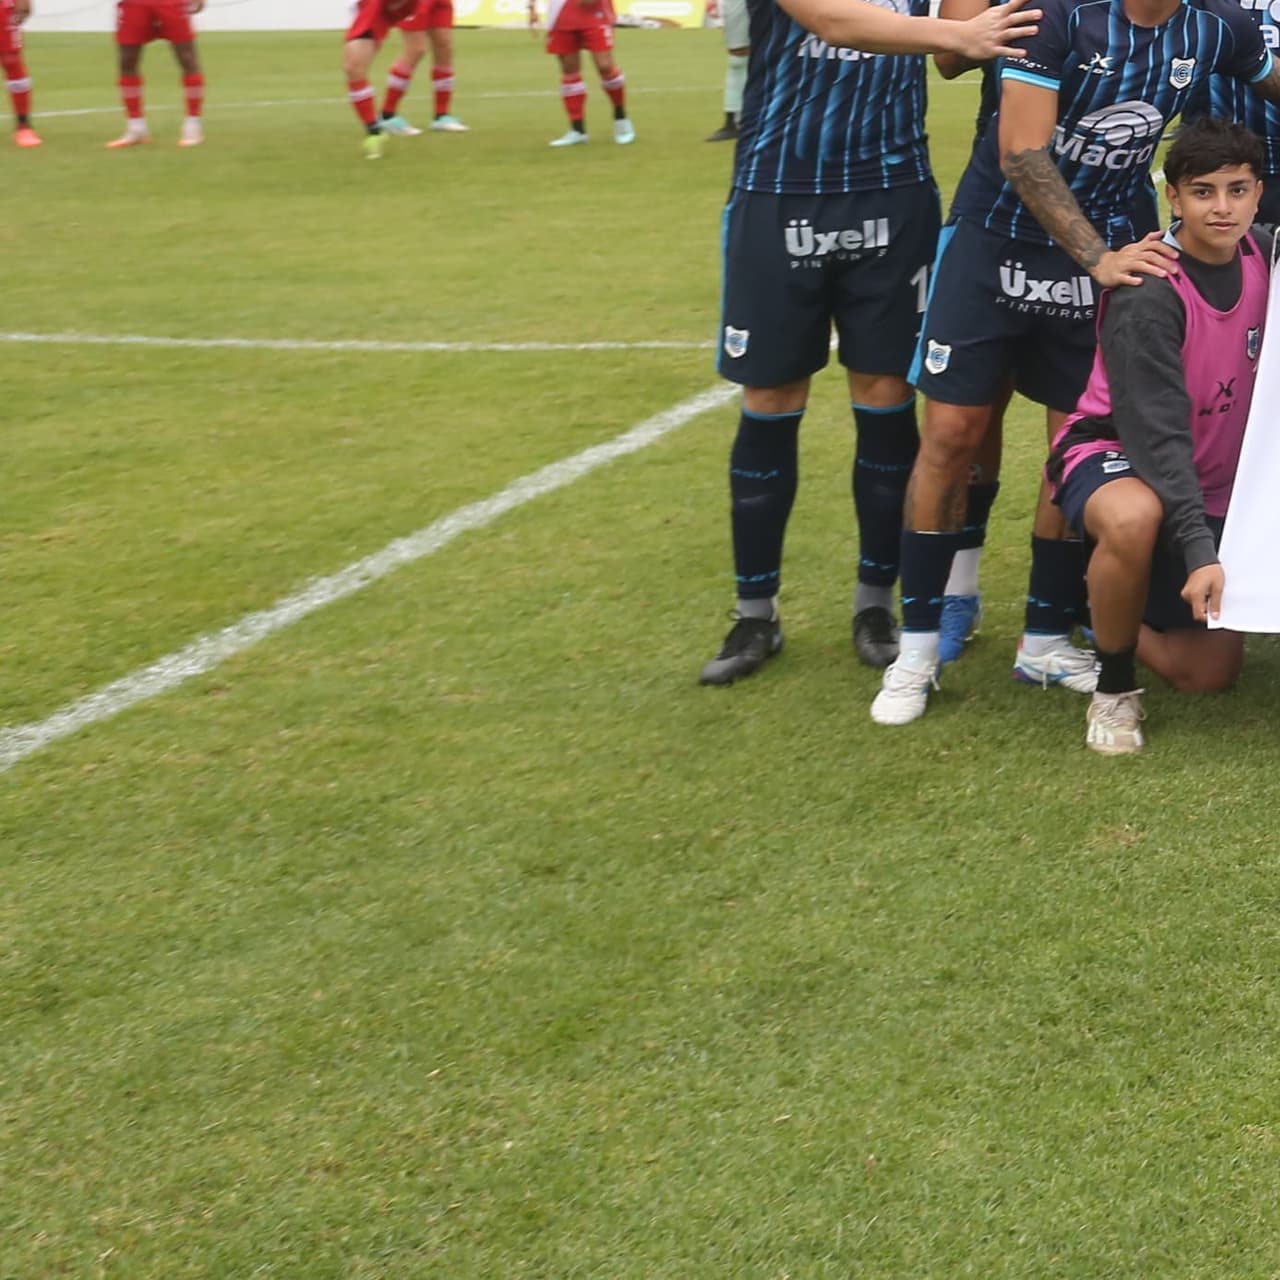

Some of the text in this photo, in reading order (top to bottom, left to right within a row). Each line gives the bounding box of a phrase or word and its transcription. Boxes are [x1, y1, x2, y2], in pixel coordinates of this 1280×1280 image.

[784, 218, 890, 257] Üxell
[1000, 259, 1095, 308] Üxell
[994, 296, 1095, 320] PINTURAS
